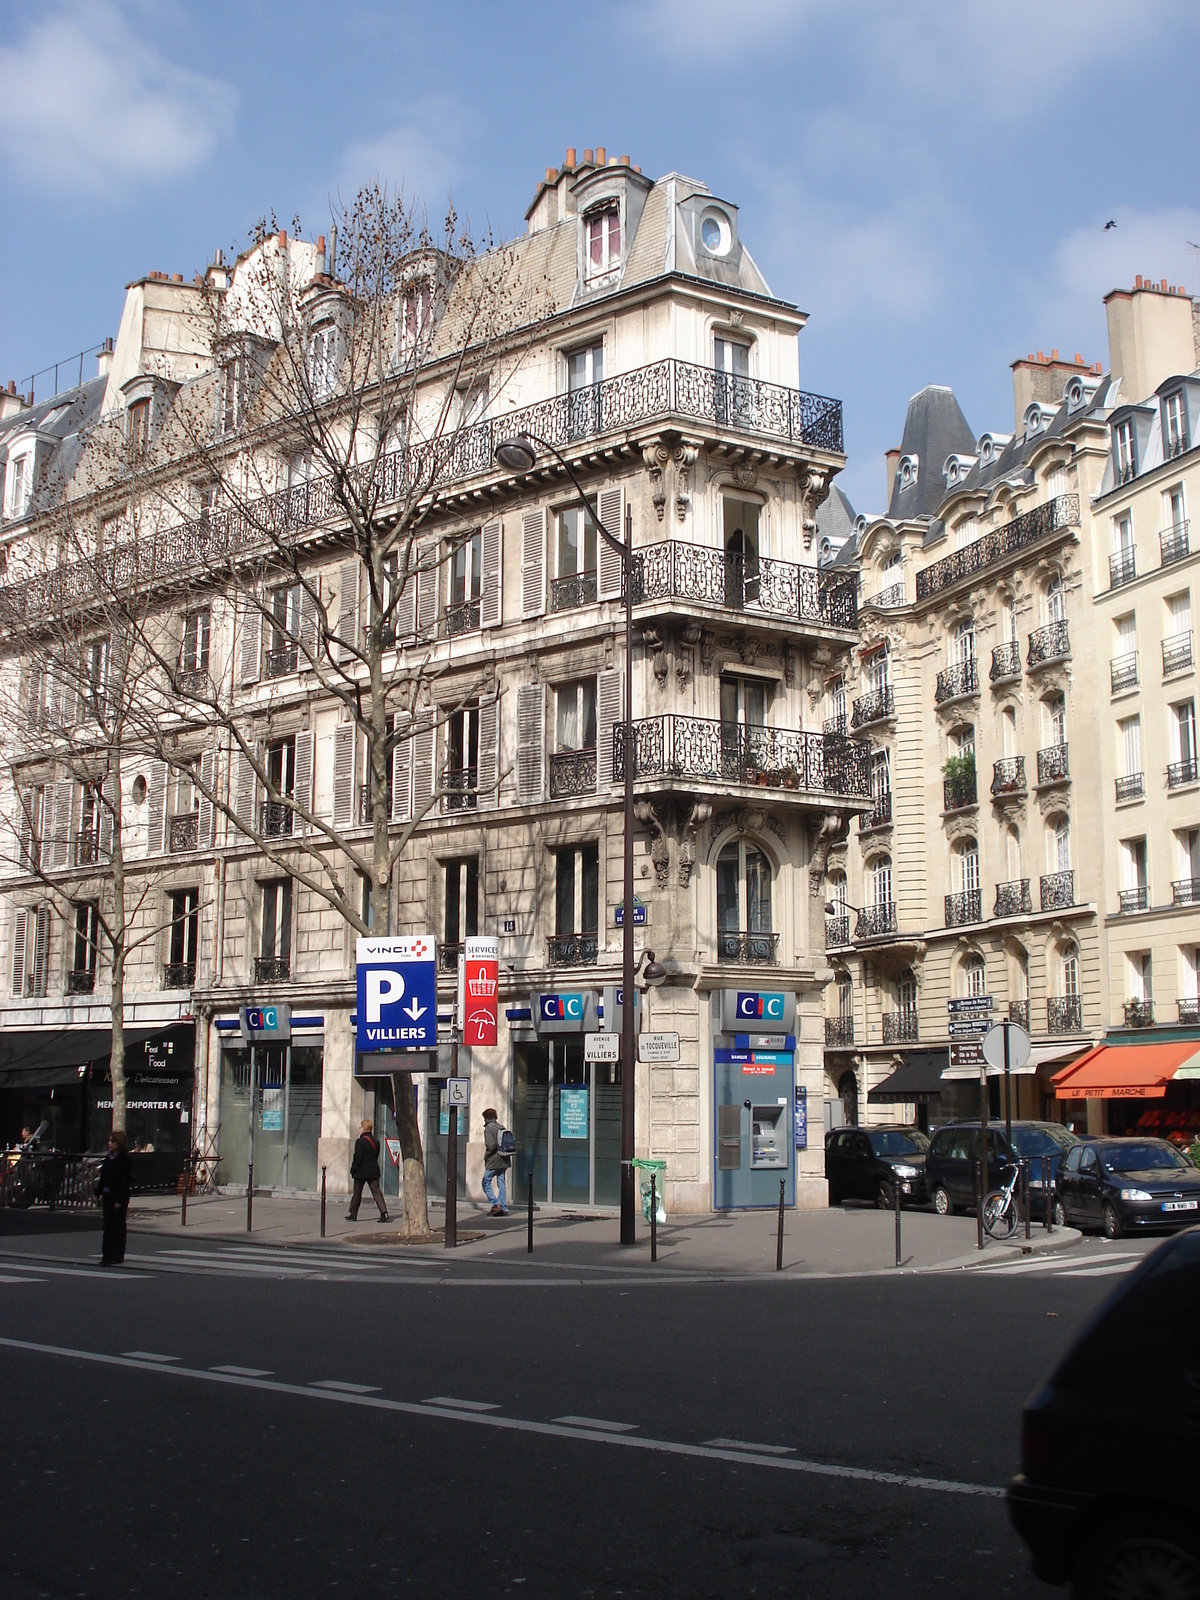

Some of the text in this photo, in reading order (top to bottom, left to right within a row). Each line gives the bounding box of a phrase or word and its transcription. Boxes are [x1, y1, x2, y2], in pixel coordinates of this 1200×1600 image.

[506, 921, 514, 931] 14
[366, 946, 408, 954] VINCI
[467, 946, 499, 954] SERVICES
[365, 970, 405, 1023] P
[544, 999, 580, 1016] CIC
[741, 997, 781, 1016] CIC
[249, 1011, 276, 1027] CIC
[366, 1028, 426, 1040] VILLIERS
[646, 1042, 678, 1050] TOCQUEVILLE
[586, 1051, 617, 1059] VILLIERS
[148, 1055, 166, 1067] Food
[135, 1073, 179, 1084] Delicatessen
[126, 1101, 168, 1109] EMPORTER
